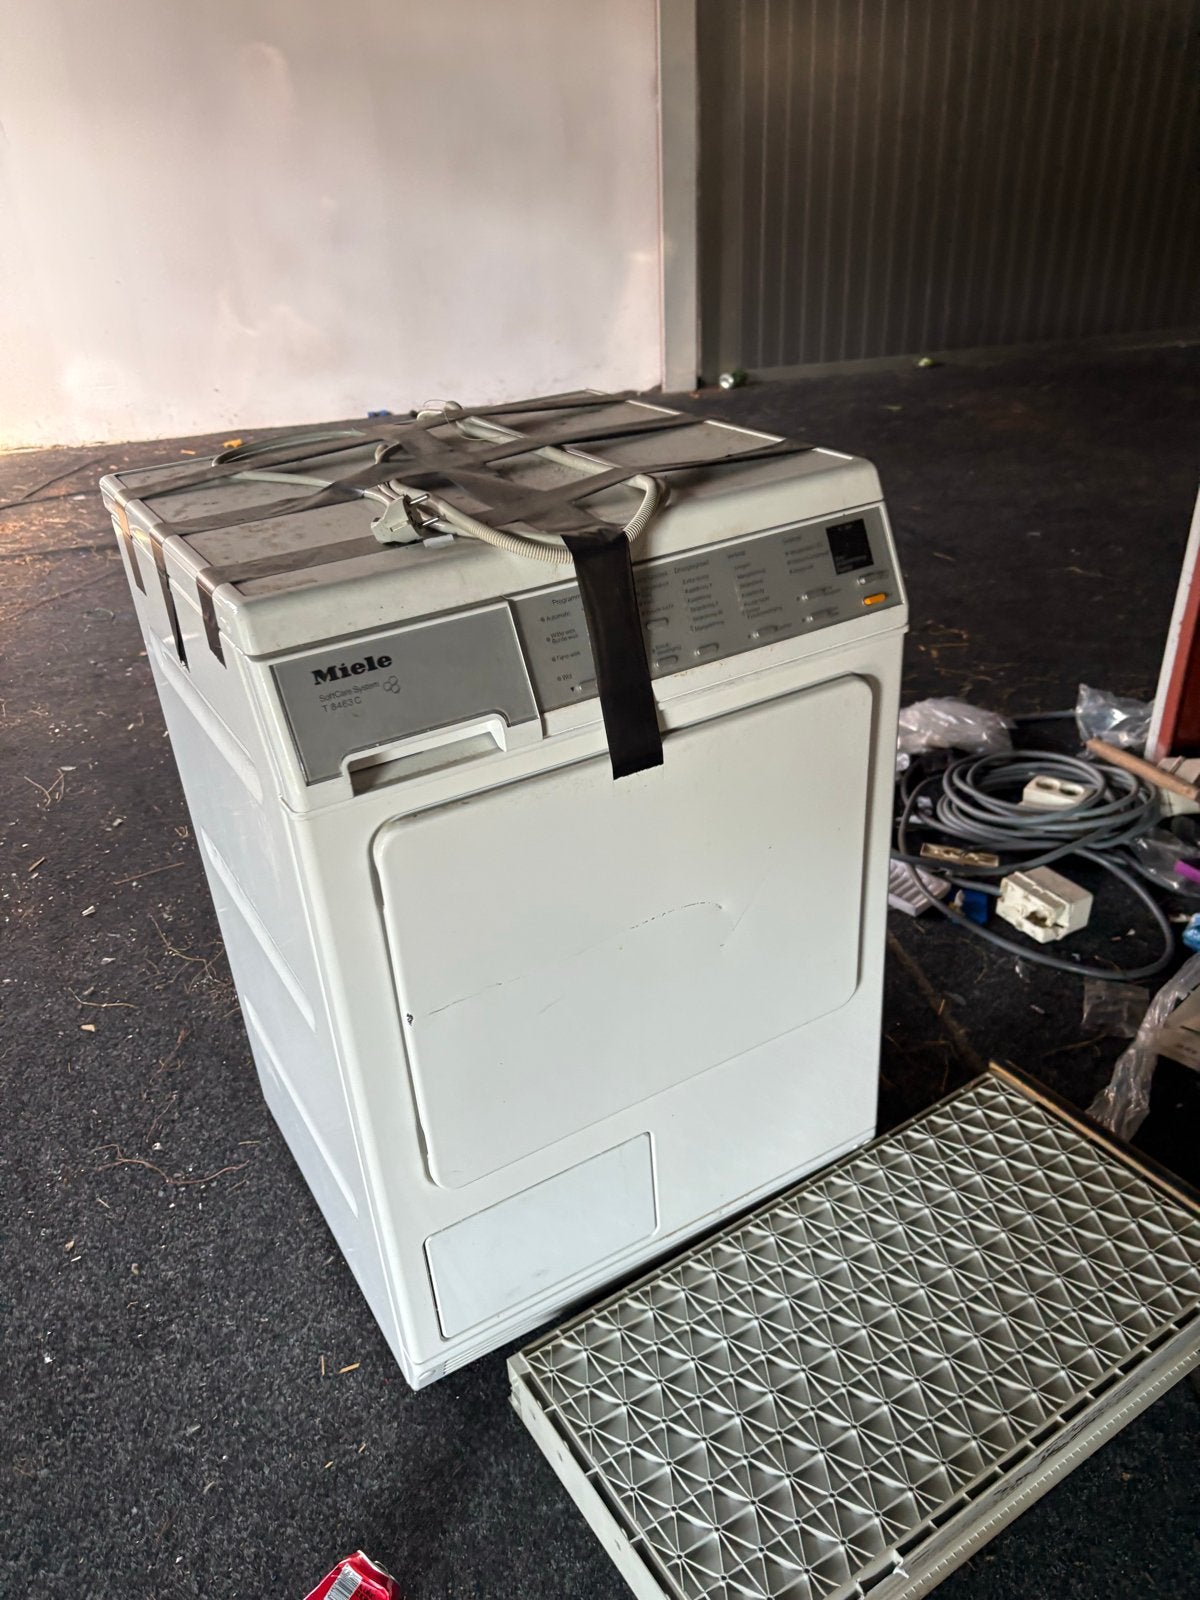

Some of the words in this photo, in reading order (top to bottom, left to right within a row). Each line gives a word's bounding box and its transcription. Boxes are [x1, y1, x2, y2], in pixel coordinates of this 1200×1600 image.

[311, 655, 393, 686] Miele
[319, 688, 352, 702] SoftCare
[352, 682, 379, 693] System
[322, 704, 328, 713] T
[354, 696, 362, 705] C
